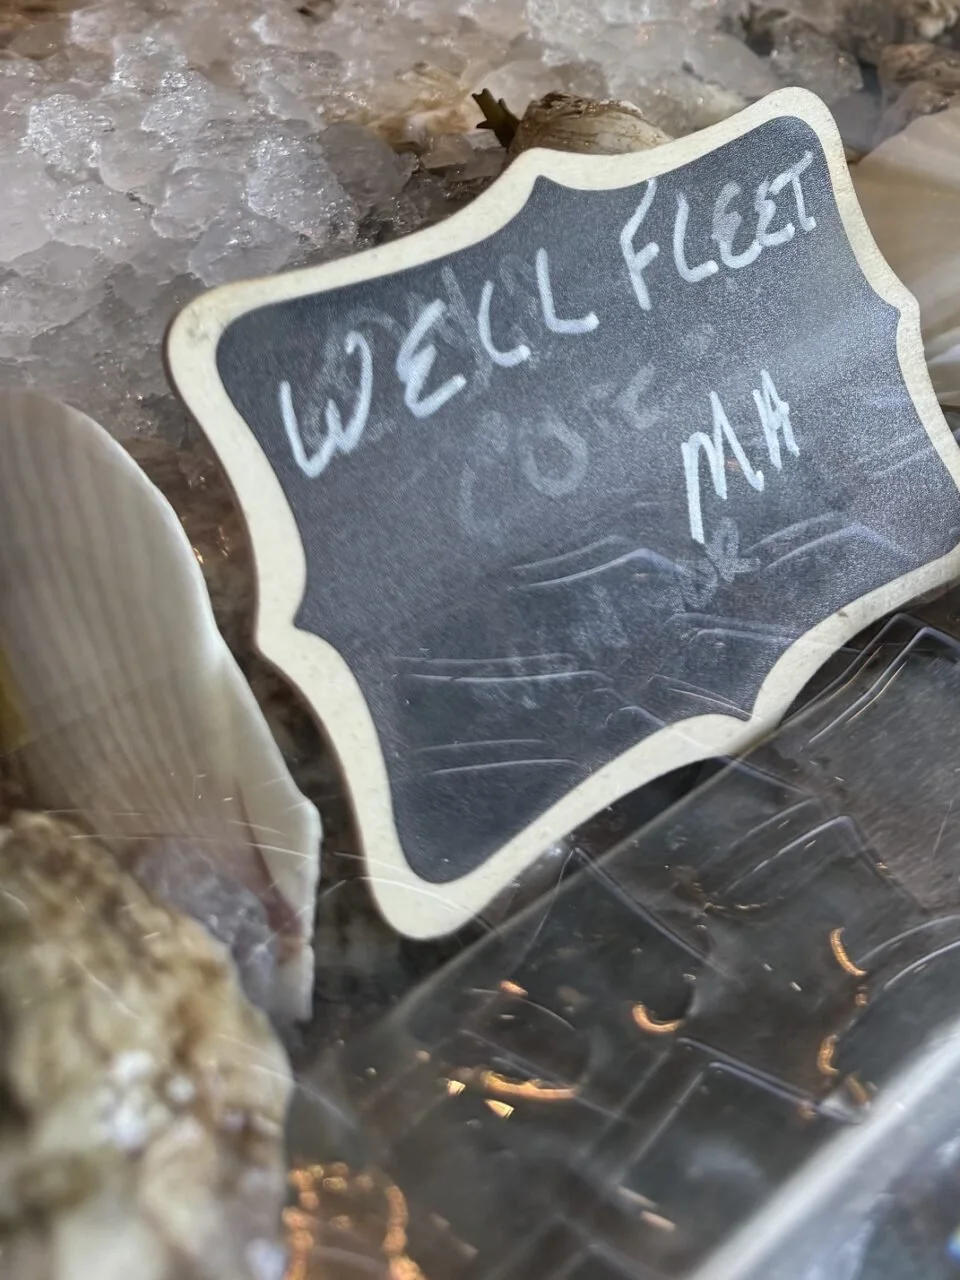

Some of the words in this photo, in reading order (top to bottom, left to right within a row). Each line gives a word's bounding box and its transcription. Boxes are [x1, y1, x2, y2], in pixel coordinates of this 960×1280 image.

[277, 247, 600, 479] WELL
[620, 151, 817, 312] FLEET
[680, 368, 801, 545] MA
